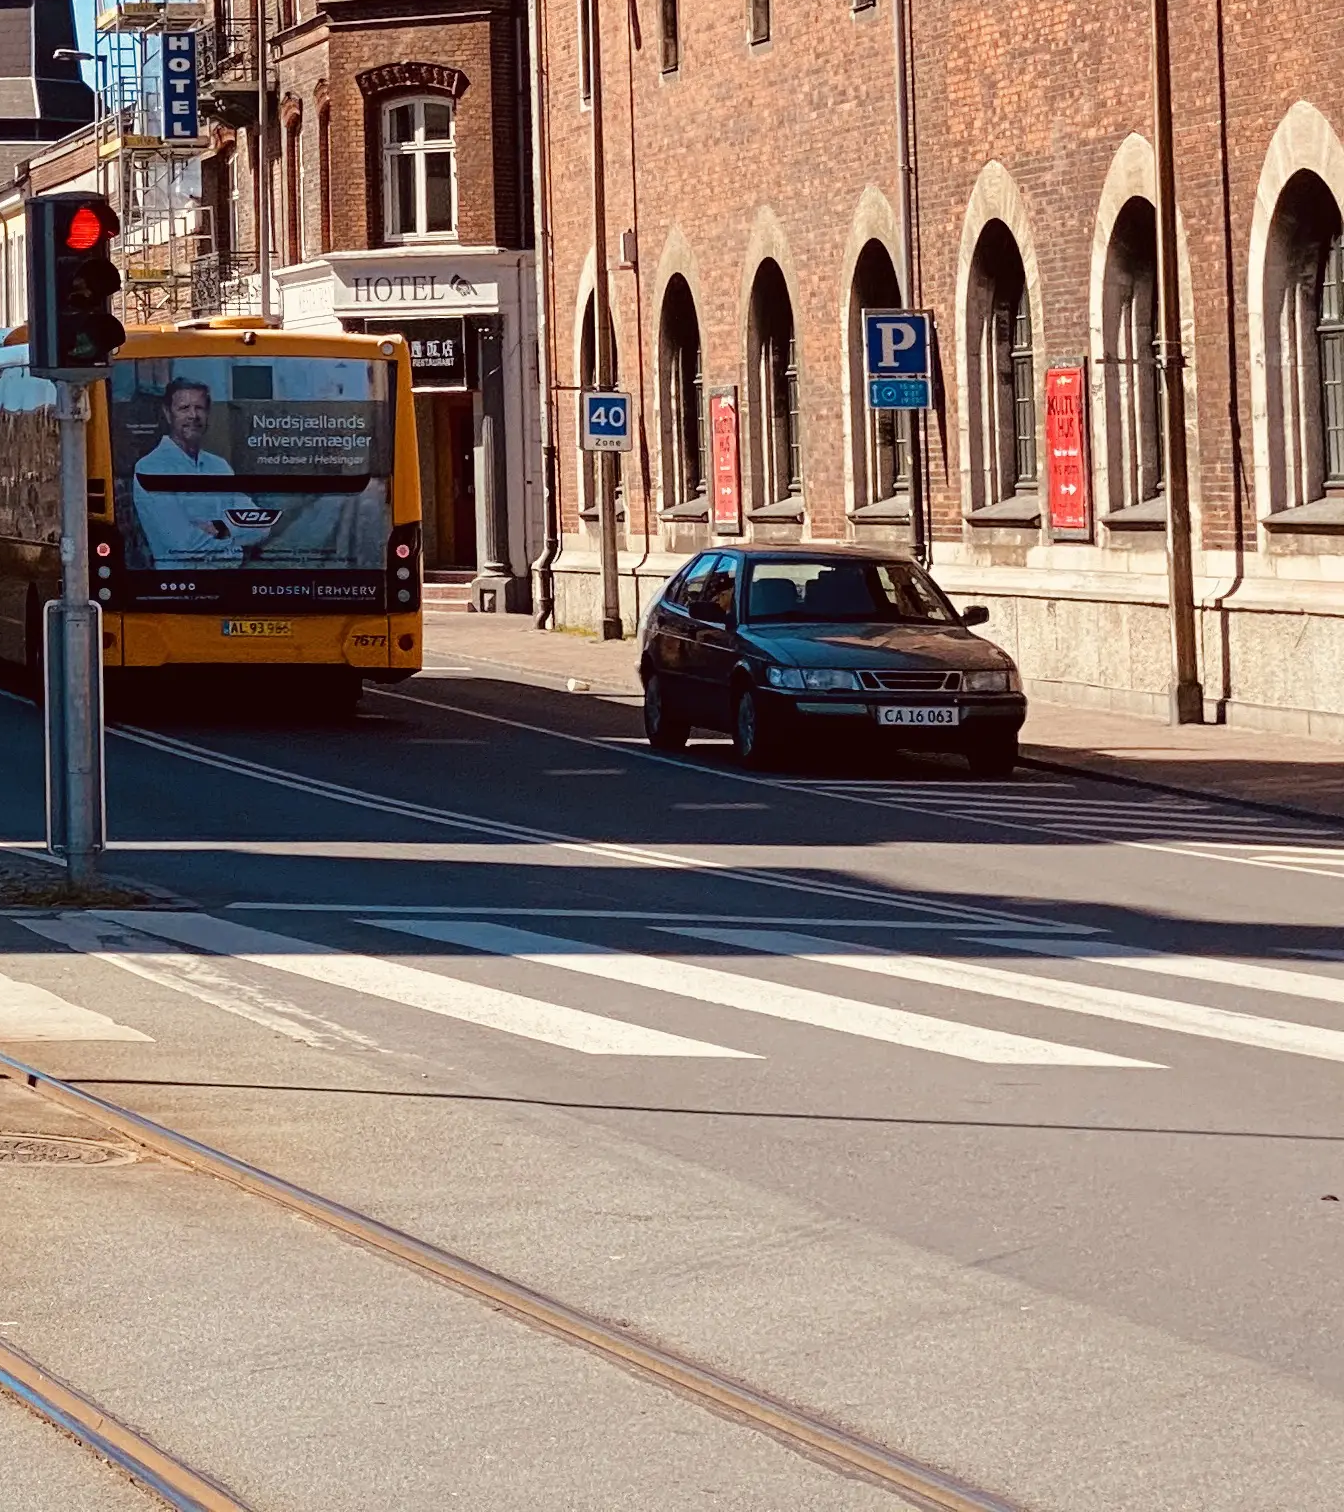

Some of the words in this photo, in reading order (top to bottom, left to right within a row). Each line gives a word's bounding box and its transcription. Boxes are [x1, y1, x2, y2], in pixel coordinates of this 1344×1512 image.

[168, 36, 191, 136] HOTEL
[352, 275, 445, 302] HOTEL
[876, 322, 917, 367] P
[253, 415, 366, 432] Nordsjællands
[590, 406, 625, 428] 40
[248, 434, 372, 451] erhvervsmægler
[595, 438, 622, 447] Zone
[257, 455, 279, 465] med
[282, 455, 307, 465] base
[315, 455, 364, 467] Helsingør
[235, 511, 271, 522] VDL
[317, 585, 377, 595] ERHVERV
[231, 622, 246, 634] AL
[884, 709, 904, 723] CA
[908, 710, 924, 723] 16
[928, 710, 953, 724] 063
